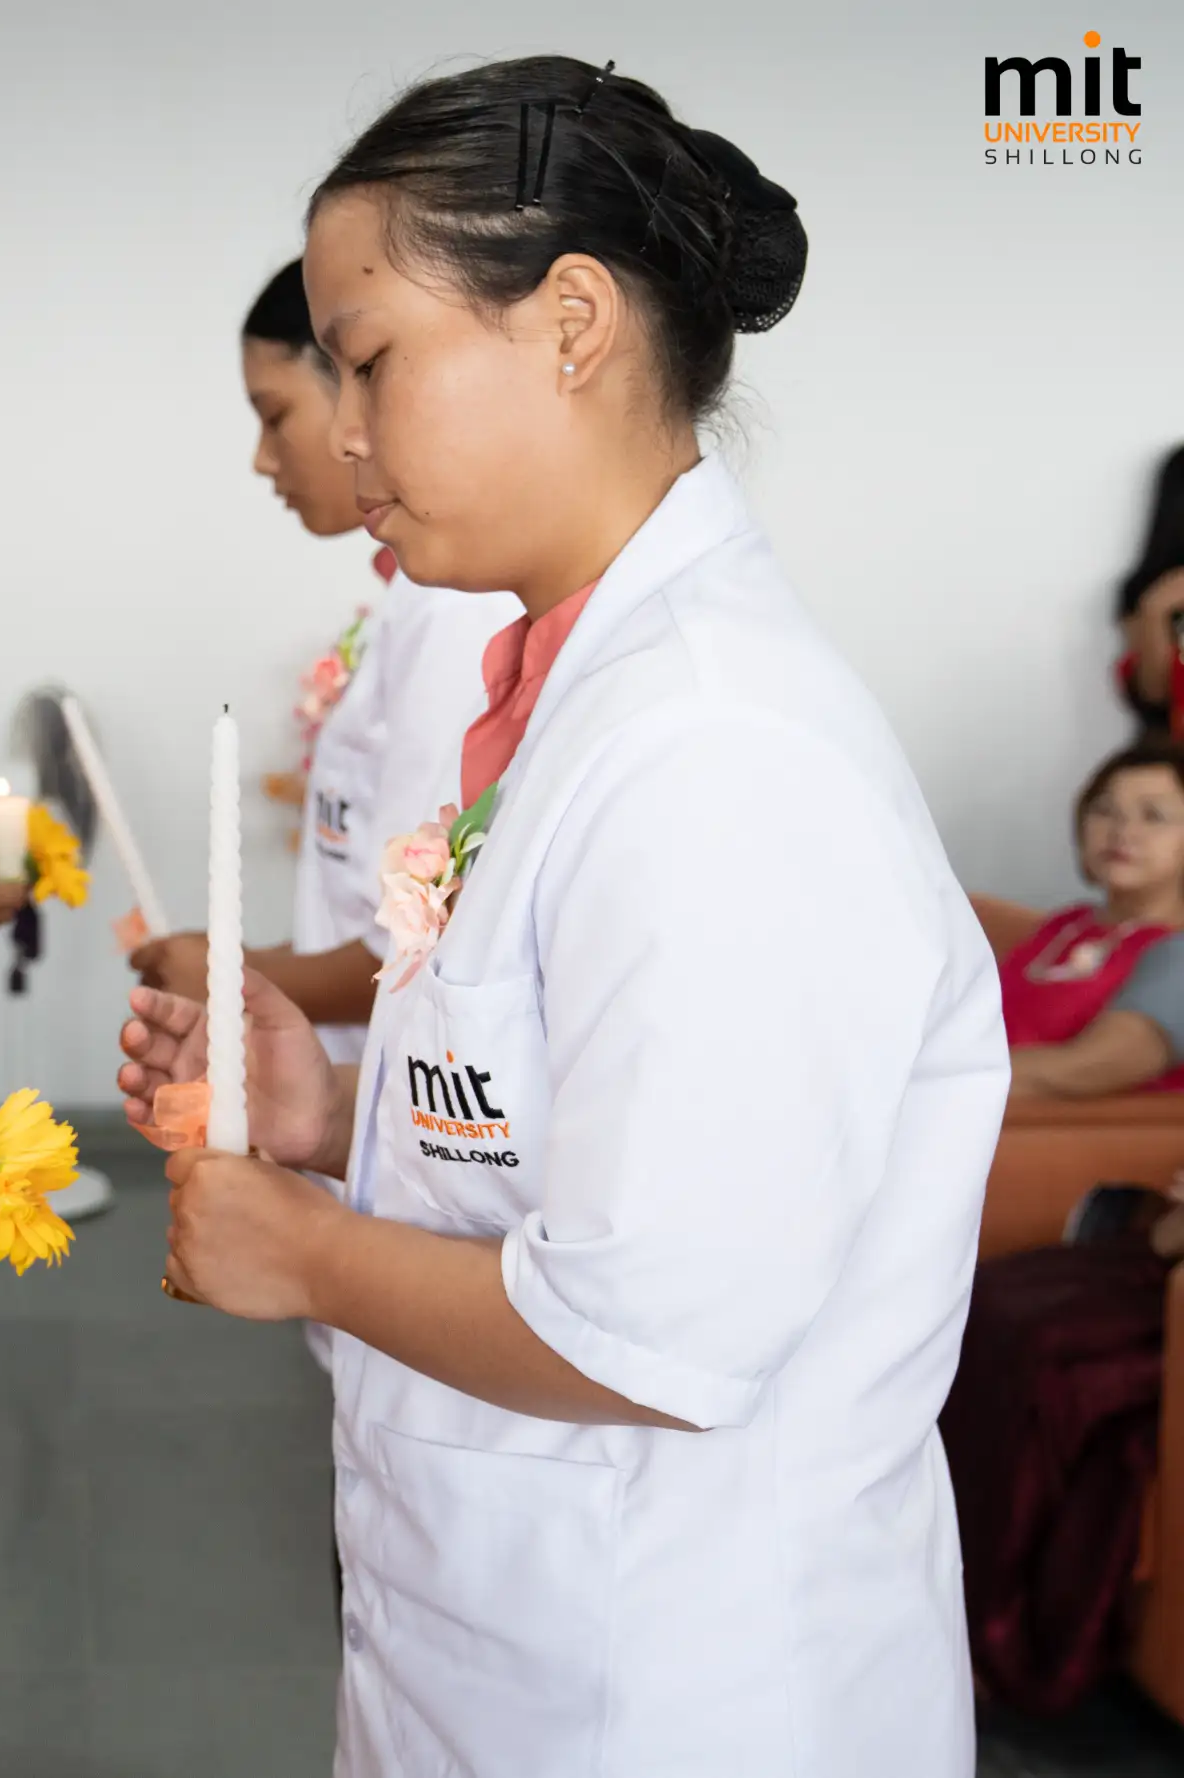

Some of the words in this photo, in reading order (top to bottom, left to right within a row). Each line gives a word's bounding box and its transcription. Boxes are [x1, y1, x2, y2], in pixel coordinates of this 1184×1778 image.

[407, 1049, 505, 1120] mit
[411, 1107, 510, 1139] UNIVERSITY
[419, 1139, 520, 1167] SHILLONG
